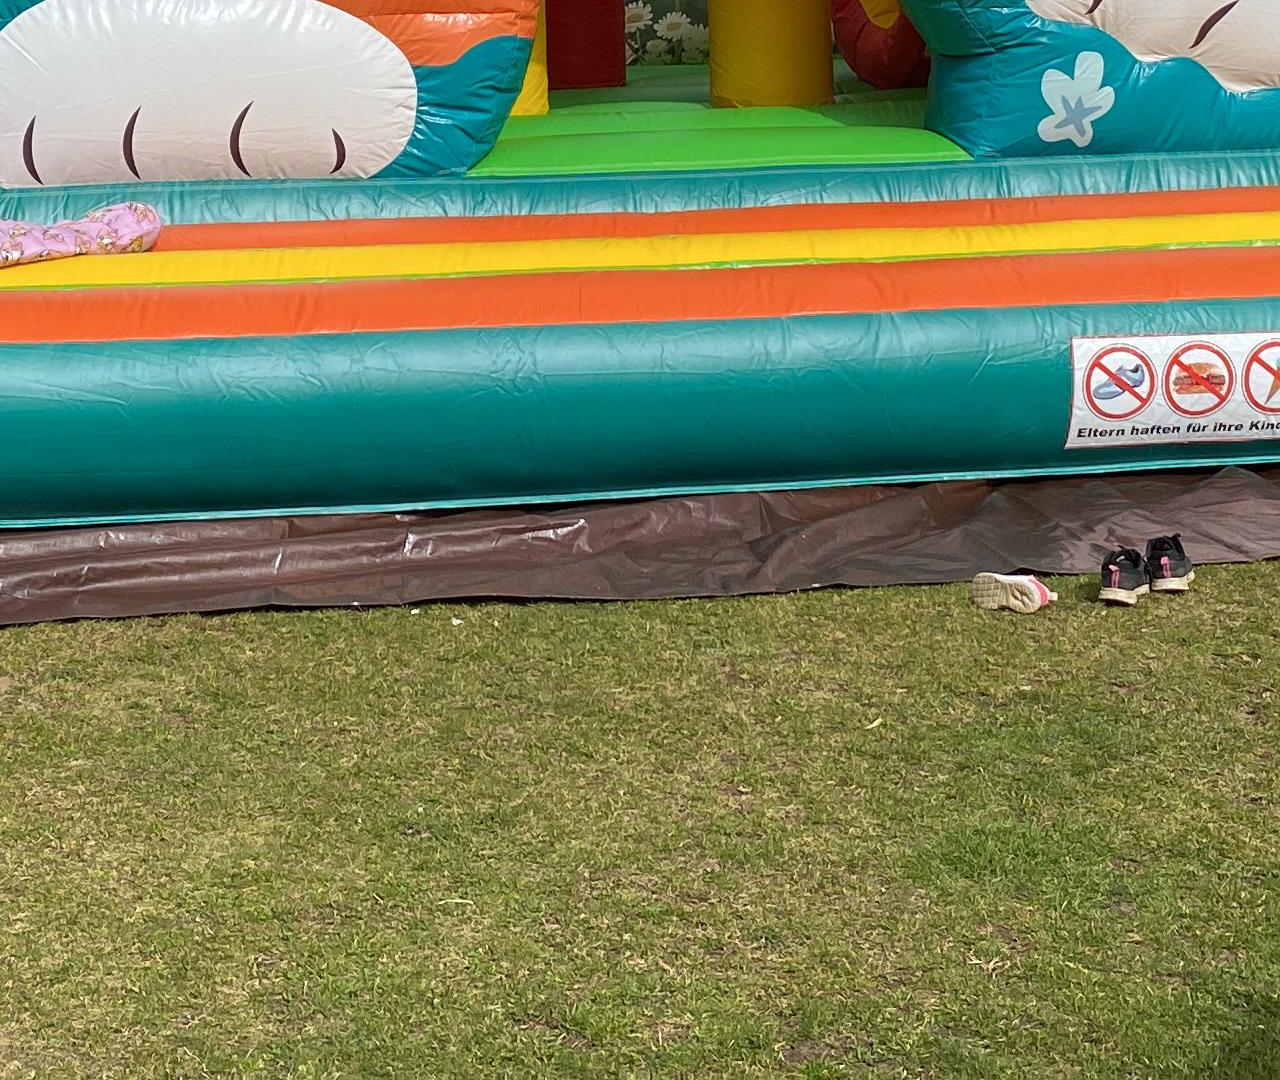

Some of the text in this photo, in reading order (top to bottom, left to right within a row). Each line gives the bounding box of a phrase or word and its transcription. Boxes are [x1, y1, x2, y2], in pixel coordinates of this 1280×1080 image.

[1076, 427, 1126, 438] Eltern
[1130, 424, 1181, 436] haften
[1186, 422, 1209, 434] für
